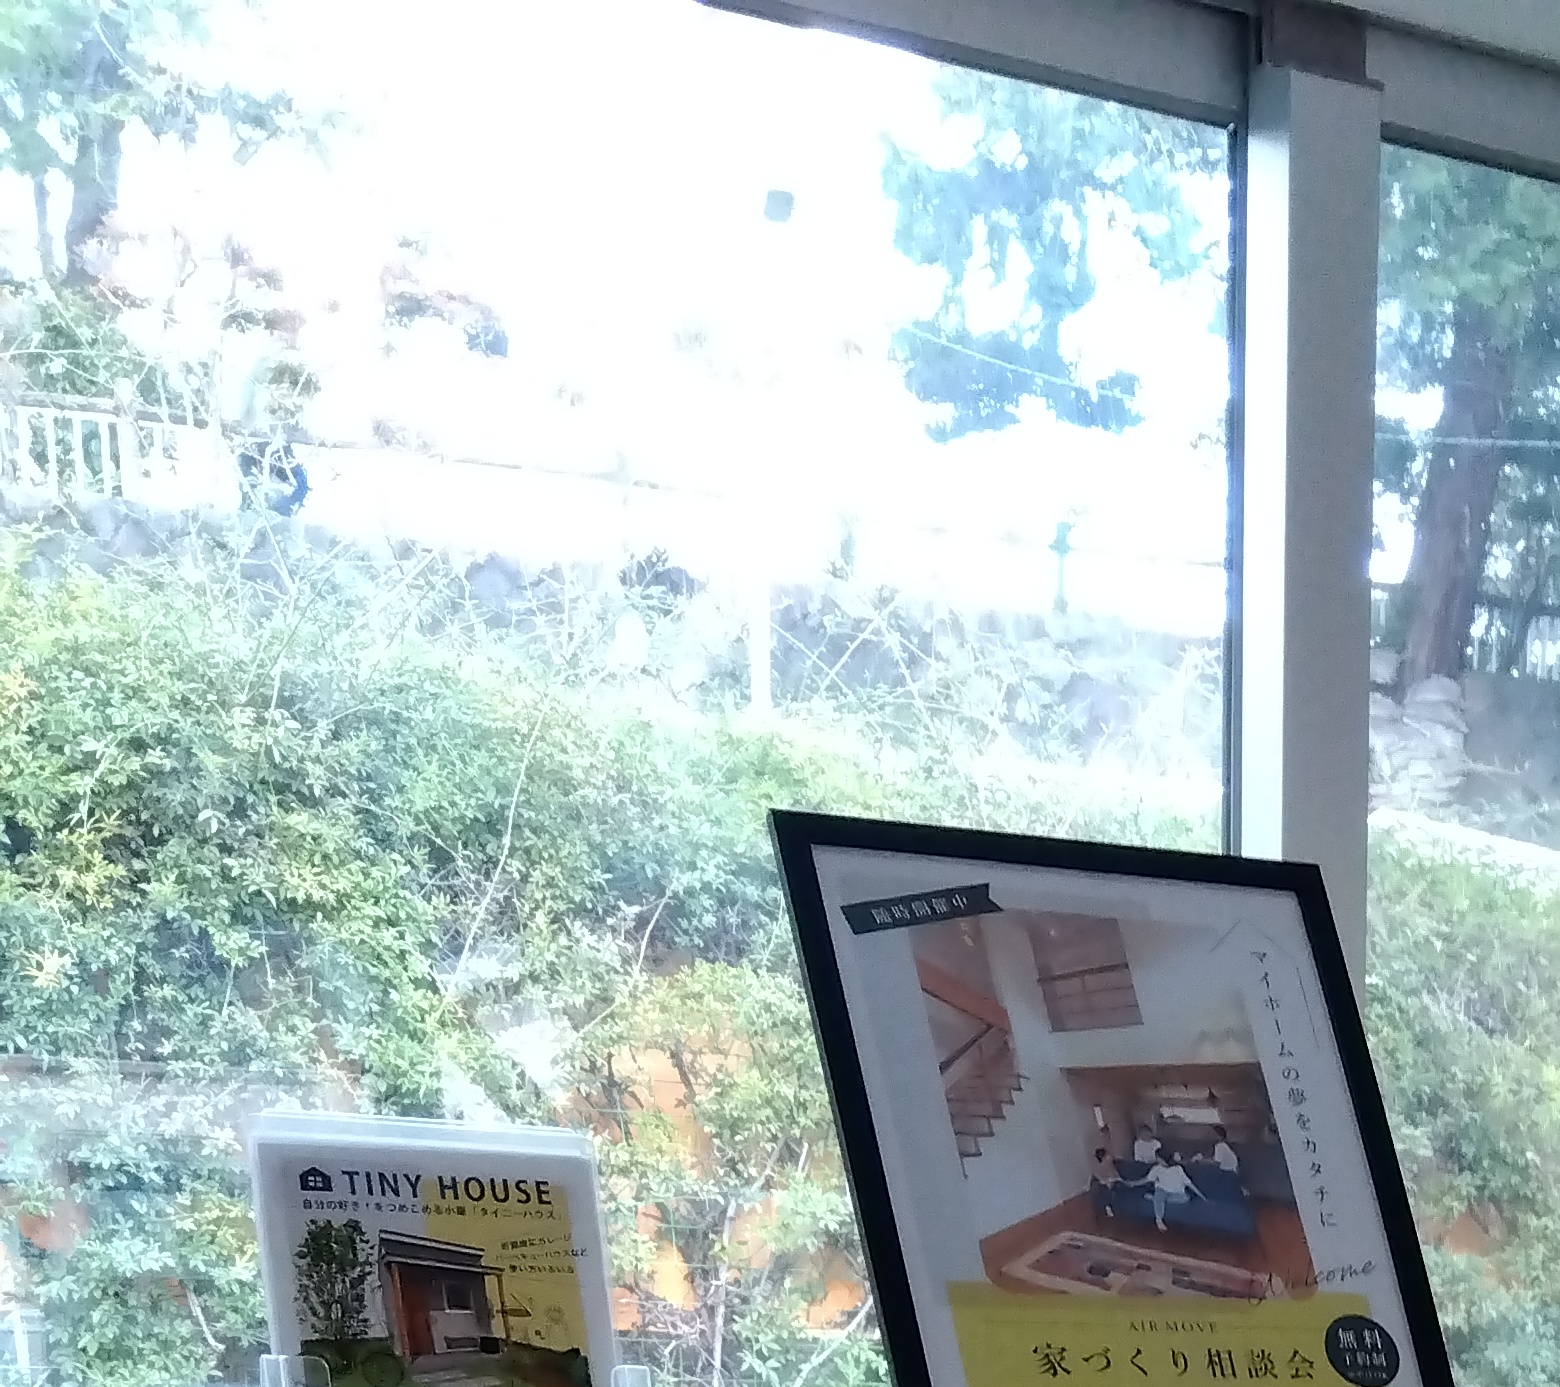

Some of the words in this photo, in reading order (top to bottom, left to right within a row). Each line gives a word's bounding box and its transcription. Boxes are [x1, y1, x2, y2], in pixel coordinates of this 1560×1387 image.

[341, 1170, 422, 1199] TINY
[437, 1175, 553, 1205] HOUSE
[1128, 1320, 1158, 1333] AIR
[1164, 1321, 1218, 1334] MOVE
[1337, 1327, 1382, 1349] 無料
[1031, 1340, 1317, 1381] 家づくり相談会
